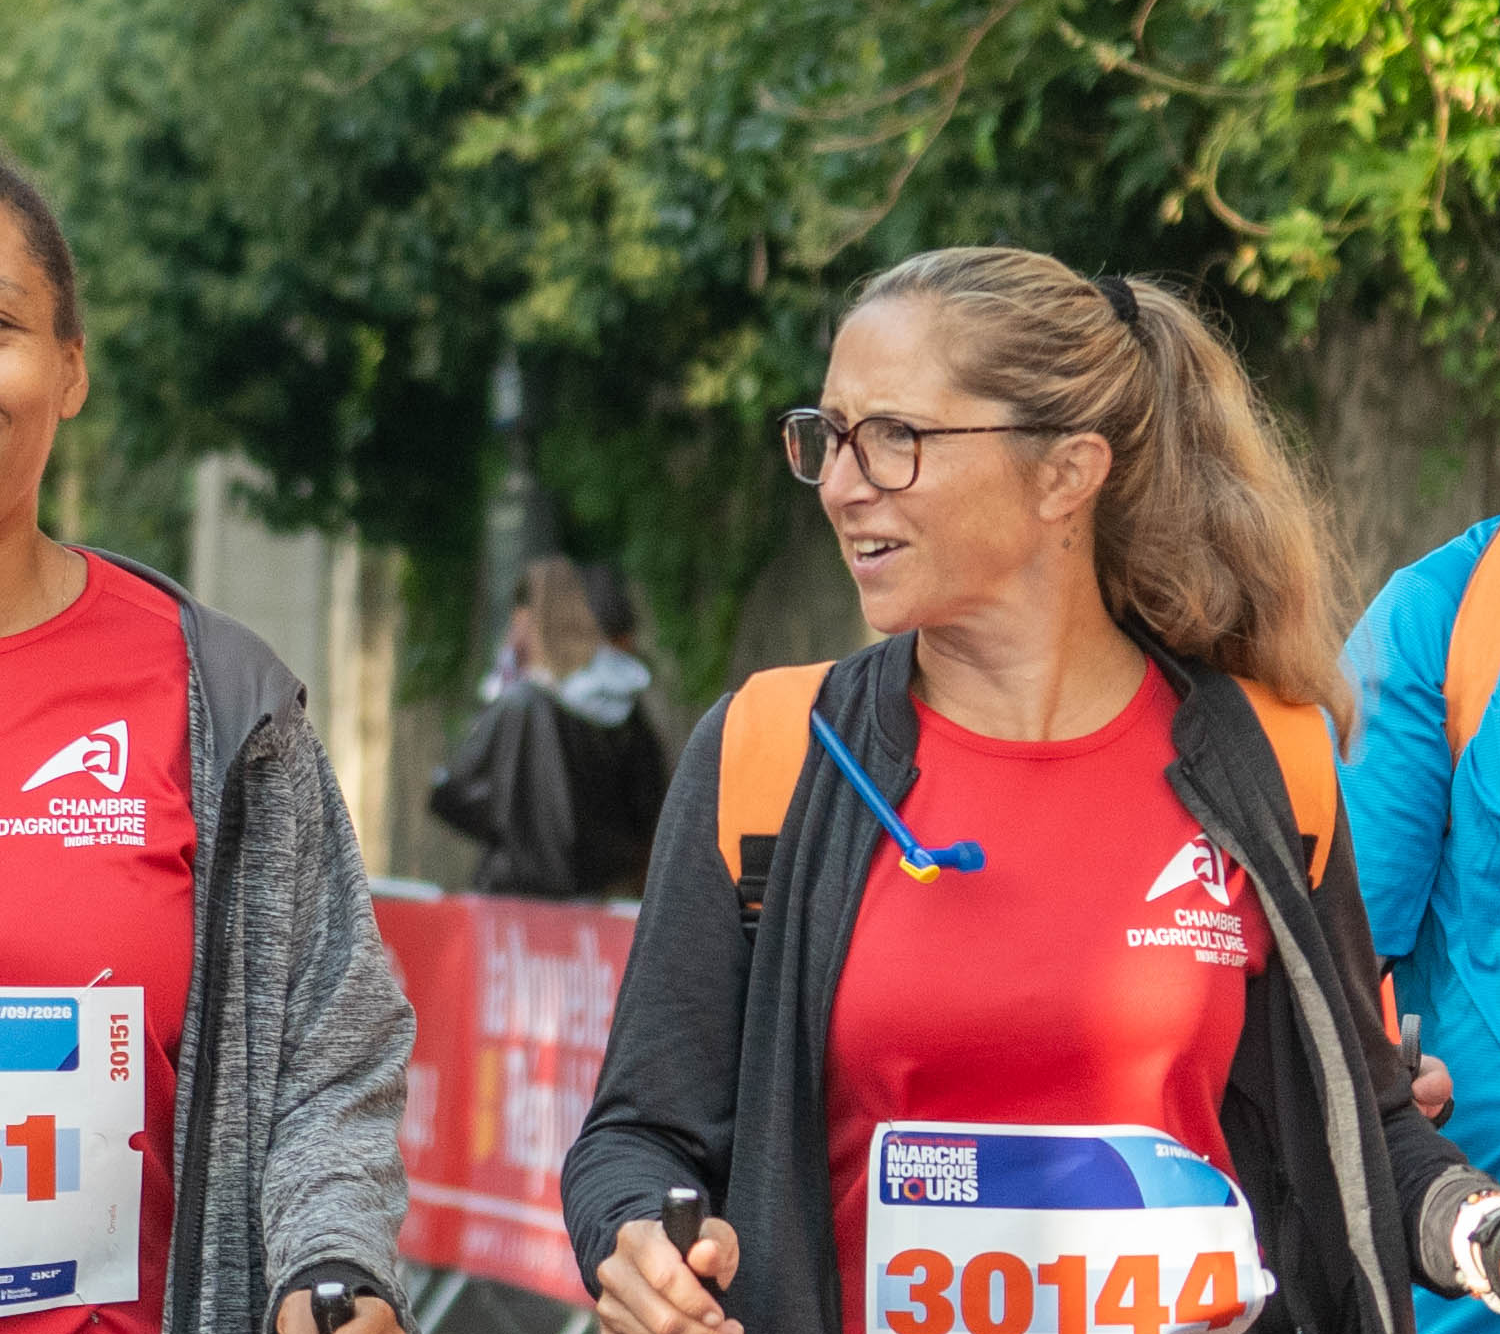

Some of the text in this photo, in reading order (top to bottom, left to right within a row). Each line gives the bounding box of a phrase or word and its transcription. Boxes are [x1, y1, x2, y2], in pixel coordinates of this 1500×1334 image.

[49, 798, 147, 816] CHAMBRE
[64, 833, 146, 848] INDRE-ET-LOIRE
[1174, 909, 1243, 935] CHAMBRE
[1126, 927, 1248, 954] D'AGRICULTURE
[109, 1013, 130, 1083] 30151
[887, 1145, 978, 1165] MARCHE
[887, 1163, 978, 1180] NORDIQUE
[887, 1177, 980, 1202] TOURS
[30, 1269, 62, 1281] SKF
